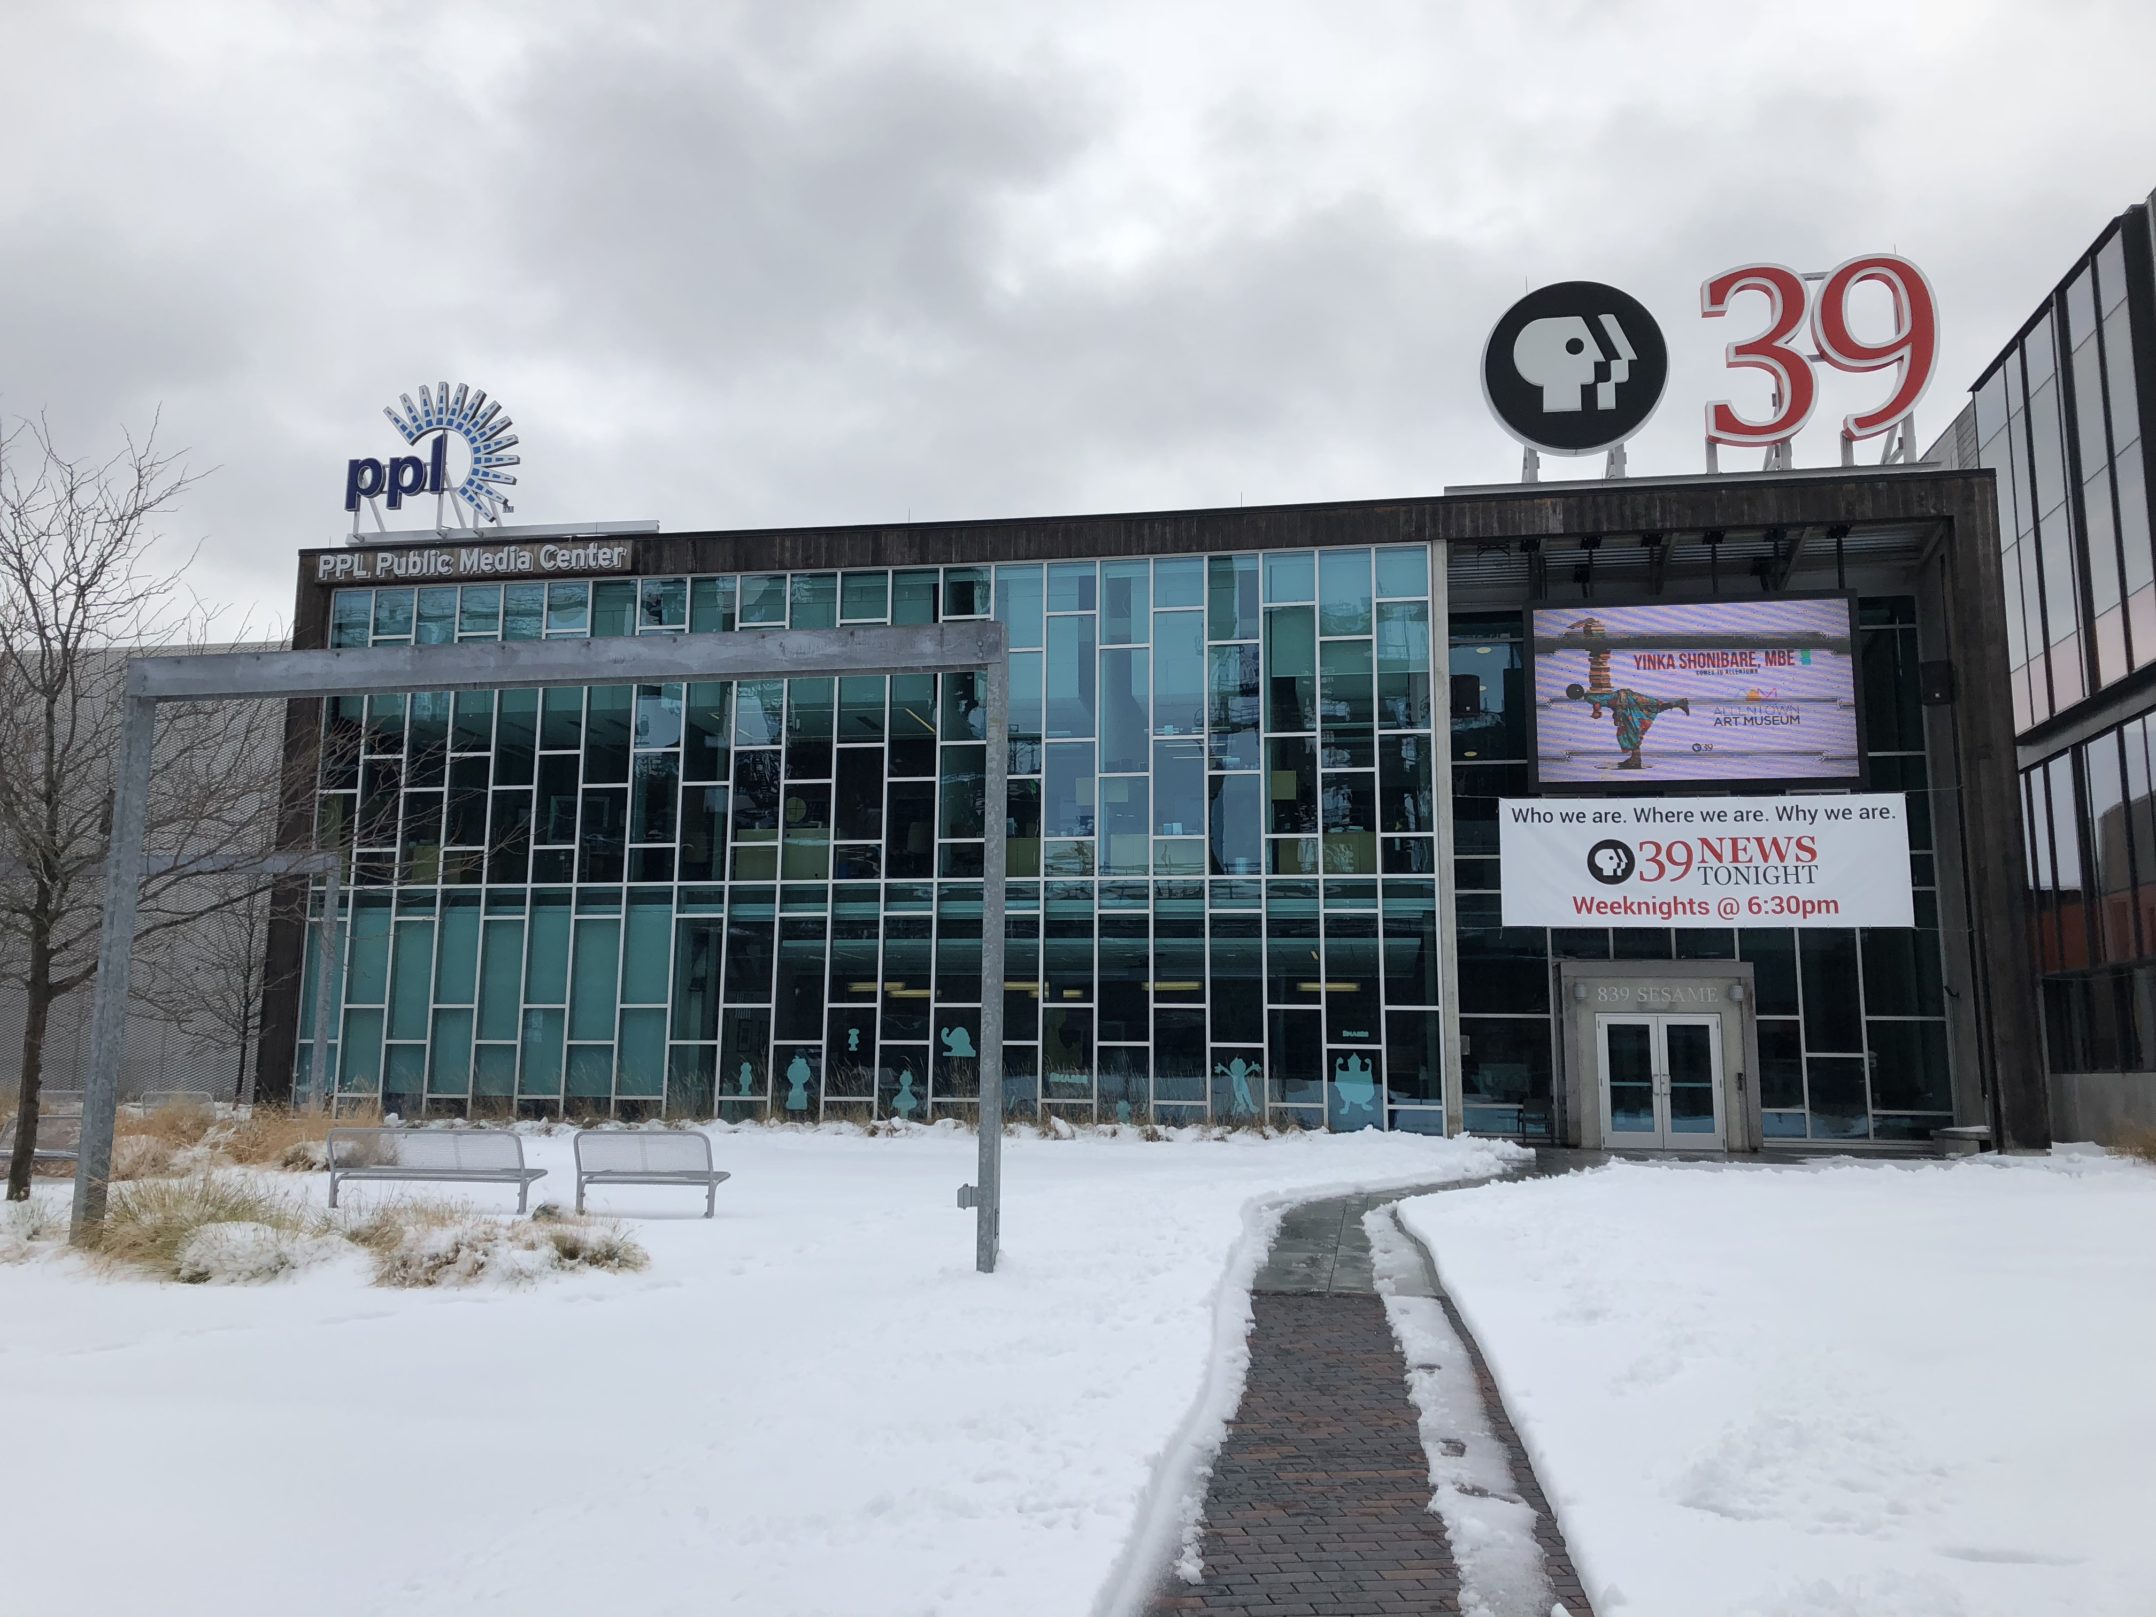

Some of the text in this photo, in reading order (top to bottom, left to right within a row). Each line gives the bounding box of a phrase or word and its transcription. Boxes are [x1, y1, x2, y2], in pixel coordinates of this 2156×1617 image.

[1700, 253, 1940, 447] 39
[345, 431, 447, 511] ppl
[318, 542, 628, 580] PPL Public Media Center
[1633, 649, 1796, 671] YINKA SHONIBARE, MBE
[1713, 715, 1801, 727] ART MUSEUM
[1511, 804, 1896, 825] Who we are. Where we are. Why we are.
[1639, 835, 1818, 883] 39 NEWS
[1697, 865, 1819, 886] TONIGHT
[1572, 895, 1840, 921] Weeknights @ 6:30pm
[1597, 986, 1719, 1003] 839 SESAME
